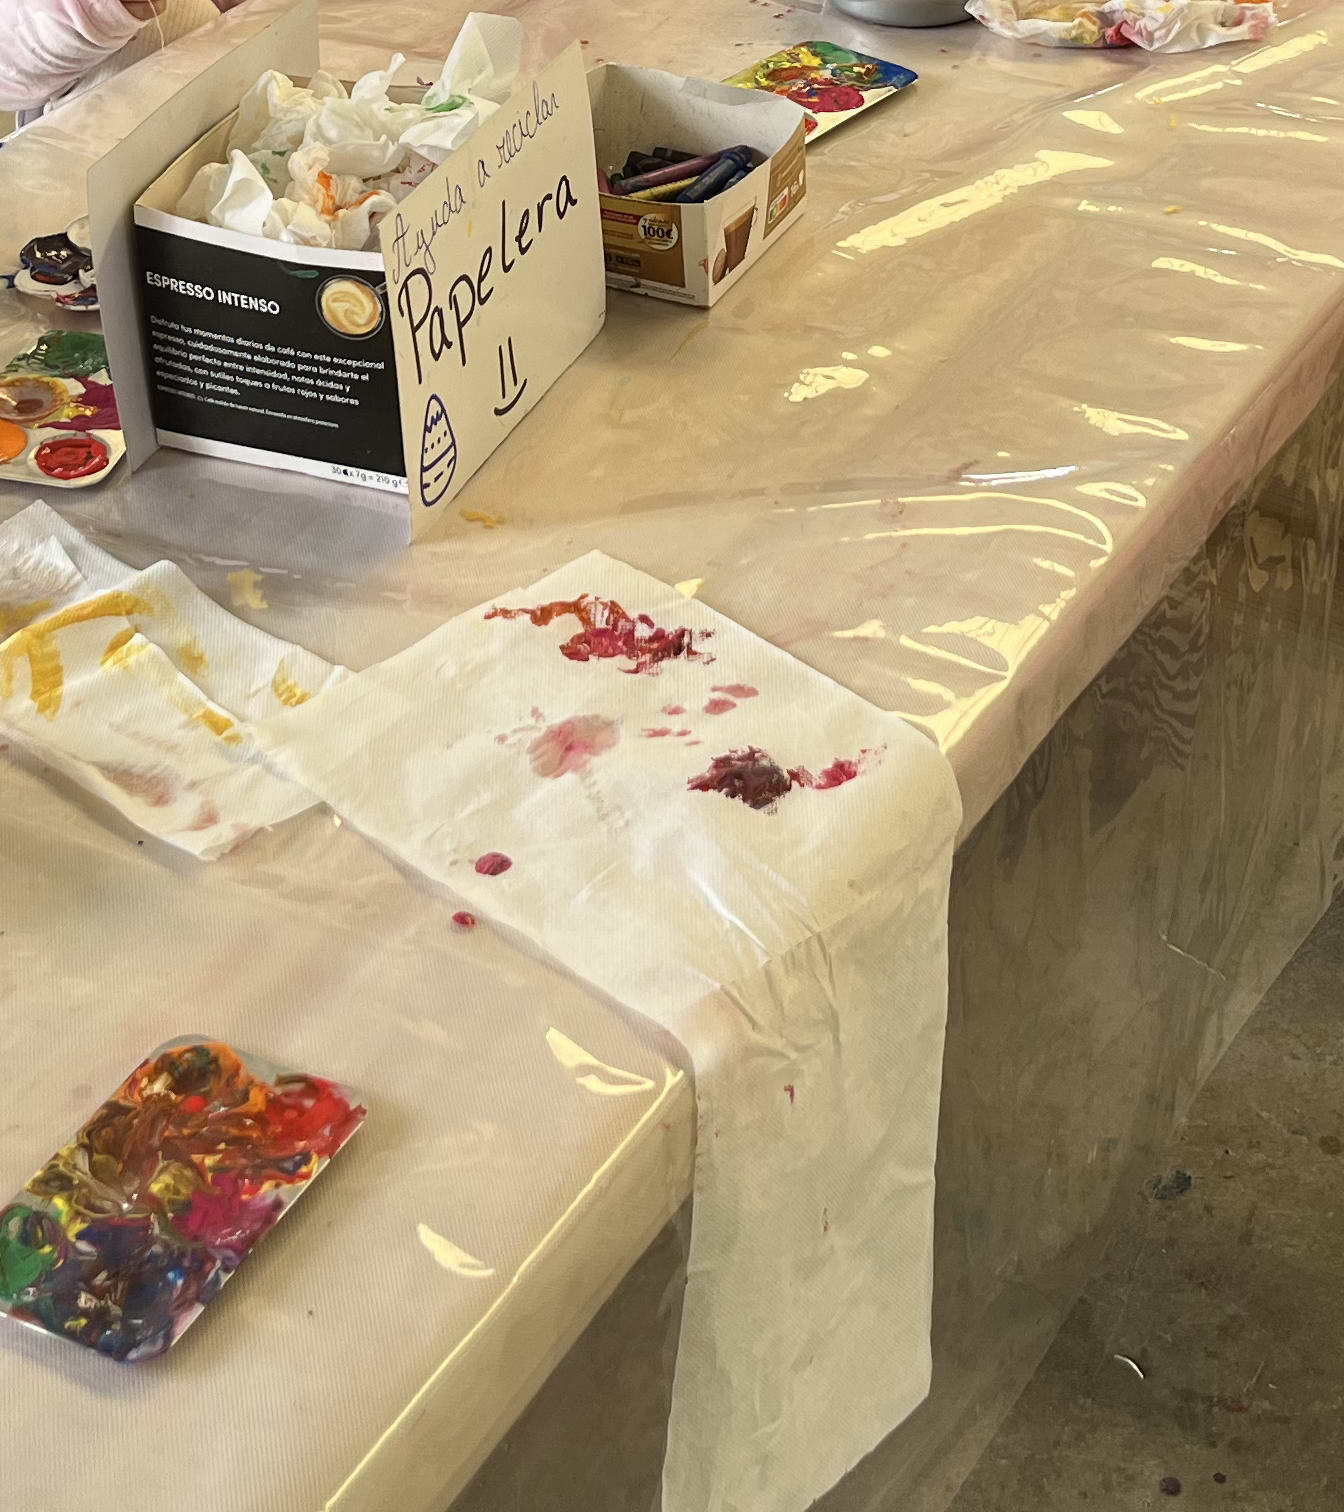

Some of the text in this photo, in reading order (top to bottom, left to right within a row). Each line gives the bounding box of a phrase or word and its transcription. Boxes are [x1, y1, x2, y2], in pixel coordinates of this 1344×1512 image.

[392, 80, 560, 285] Ayuda a reciclar
[145, 270, 281, 315] ESPRESSO INTENSO
[397, 174, 578, 385] Papelera
[186, 339, 253, 360] cuidadosamente
[253, 354, 296, 369] elaborado
[297, 363, 318, 373] para
[318, 366, 360, 380] brindarte
[360, 372, 370, 382] el
[188, 353, 223, 367] perfecto
[223, 361, 245, 372] entre
[291, 374, 315, 386] notas
[193, 328, 235, 344] momentos
[235, 336, 264, 350] diarios
[264, 343, 276, 353] de
[276, 346, 296, 357] café
[296, 350, 313, 359] con
[313, 354, 332, 363] este
[332, 356, 385, 370] excepcional
[194, 367, 209, 376] con
[209, 370, 235, 382] sutiles
[235, 375, 263, 388] toques
[271, 381, 296, 395] frutos
[296, 388, 318, 400] rojos
[325, 393, 360, 407] sabores
[205, 381, 241, 397] picantes.
